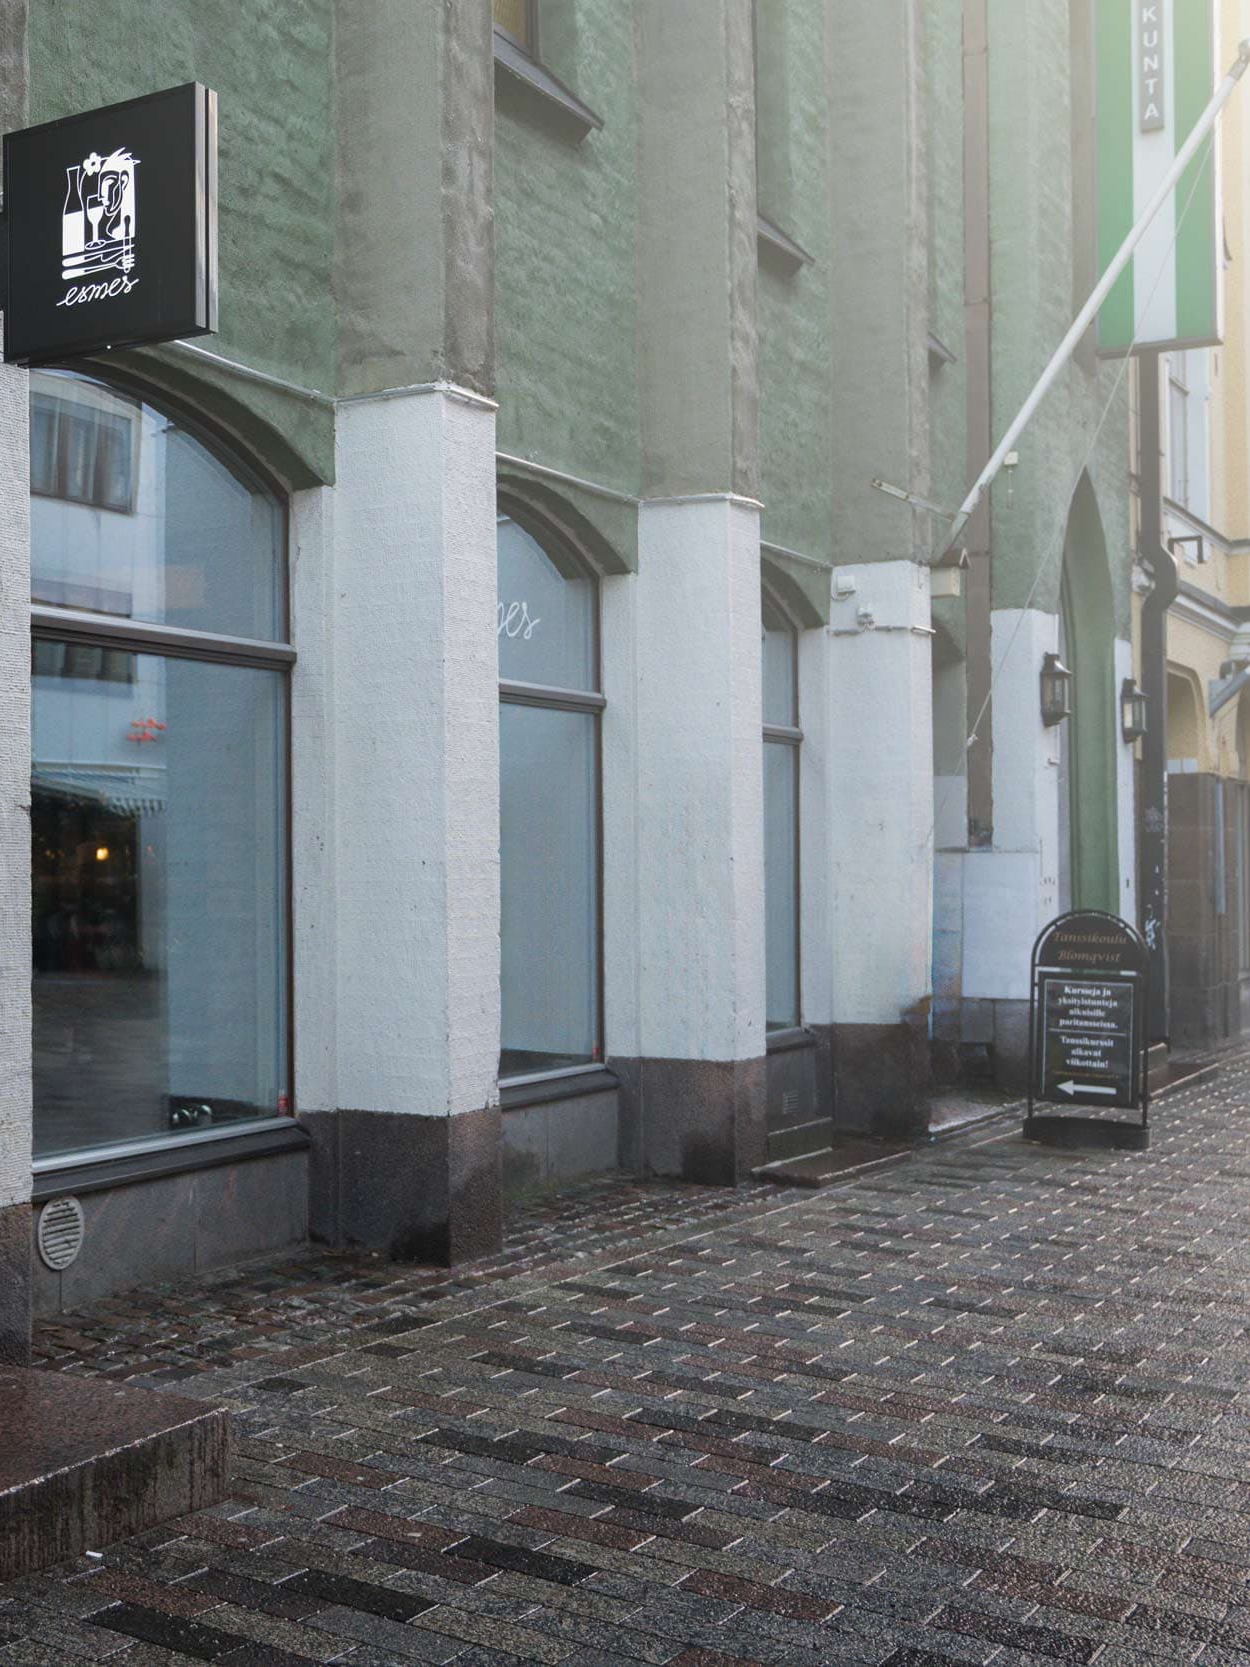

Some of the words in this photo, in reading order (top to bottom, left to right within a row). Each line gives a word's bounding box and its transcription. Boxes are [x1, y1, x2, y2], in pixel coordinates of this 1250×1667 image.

[1141, 7, 1159, 120] KUNTA
[56, 275, 139, 306] esmes
[1053, 931, 1127, 945] Tanssikoulu
[1057, 950, 1121, 964] Blomqvist
